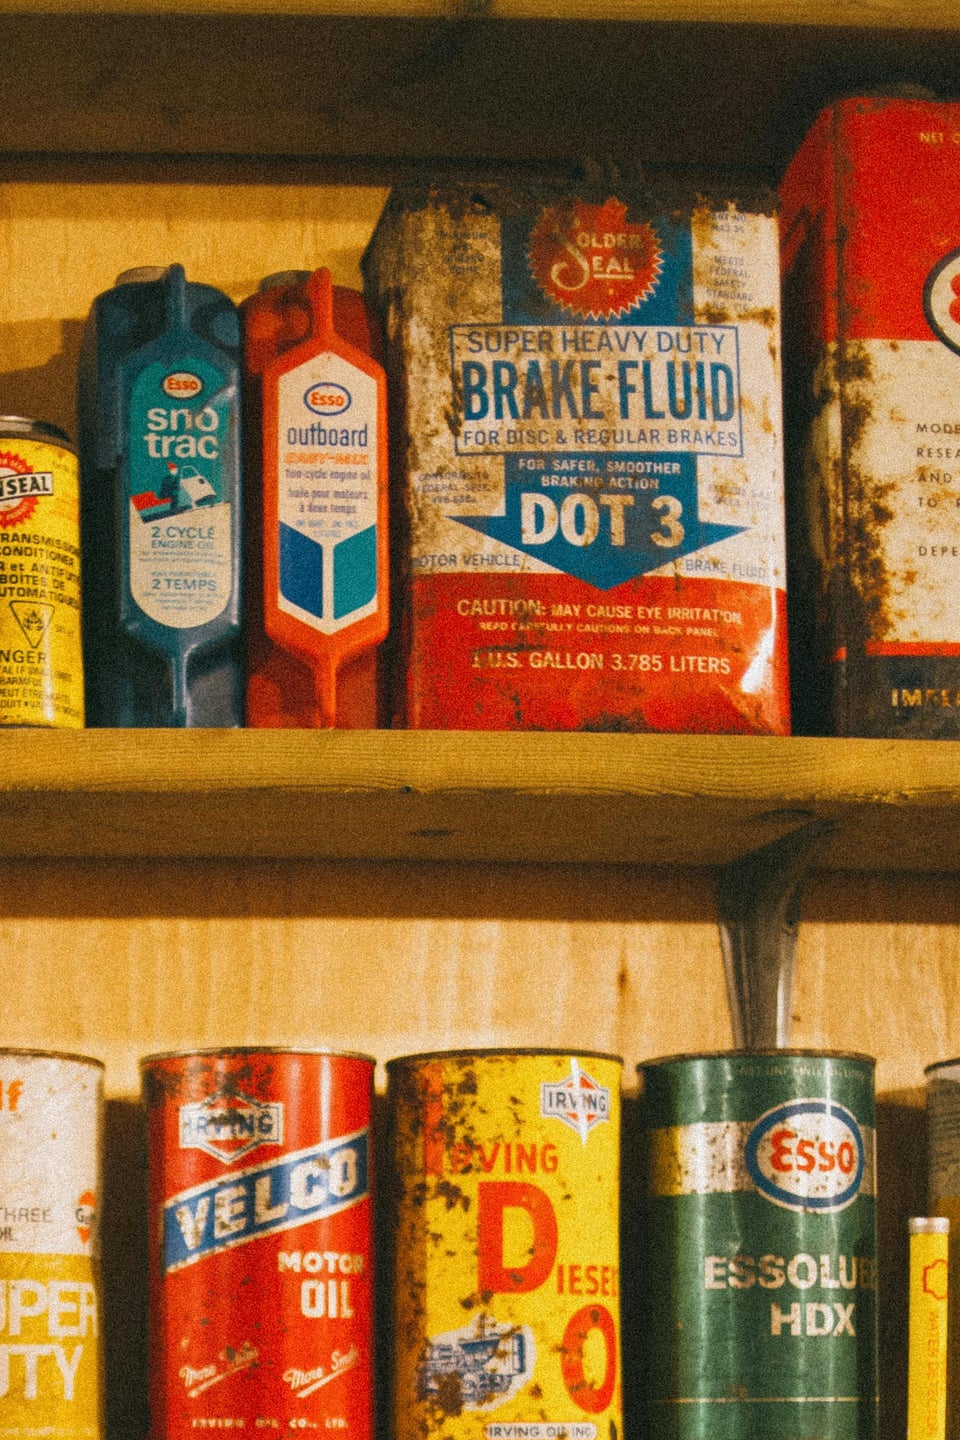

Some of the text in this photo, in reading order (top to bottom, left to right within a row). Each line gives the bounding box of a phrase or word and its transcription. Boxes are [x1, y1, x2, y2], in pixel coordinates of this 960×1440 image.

[467, 331, 726, 354] SUPER HEAVY DUTY
[167, 378, 199, 393] Esso
[461, 359, 736, 422] BRAKE FLUID
[310, 391, 347, 407] Esso
[146, 406, 220, 432] sno
[287, 421, 369, 448] outboard
[464, 429, 739, 447] FOR DISC & REGULAR BRAKES
[143, 432, 220, 460] trac
[518, 459, 545, 473] FOR
[605, 460, 682, 475] SMOOTHER
[917, 472, 954, 484] AND
[541, 476, 660, 490] BRAKING ACTION
[918, 497, 939, 508] TO
[520, 493, 636, 548] DOT
[650, 495, 686, 548] 3
[151, 526, 215, 540] 2 CYCLE
[463, 554, 521, 568] VEHICLE
[684, 558, 727, 574] BRAKE
[152, 579, 217, 591] 2 TEMPS
[550, 604, 581, 619] MAY
[585, 605, 634, 620] CAUSE
[636, 606, 663, 621] EYE
[667, 606, 743, 625] IRRITATION
[487, 652, 523, 669] U.S.
[529, 652, 605, 671] GALLON
[611, 654, 663, 673] 3.785
[669, 656, 732, 676] LITERS
[546, 1090, 608, 1114] IRVING
[769, 1128, 857, 1176] Esso
[175, 1147, 359, 1252] VELCO
[277, 1250, 365, 1275] MOTOR
[300, 1278, 355, 1320] OIL
[770, 1302, 857, 1338] HDX
[488, 1424, 541, 1438] IRVING
